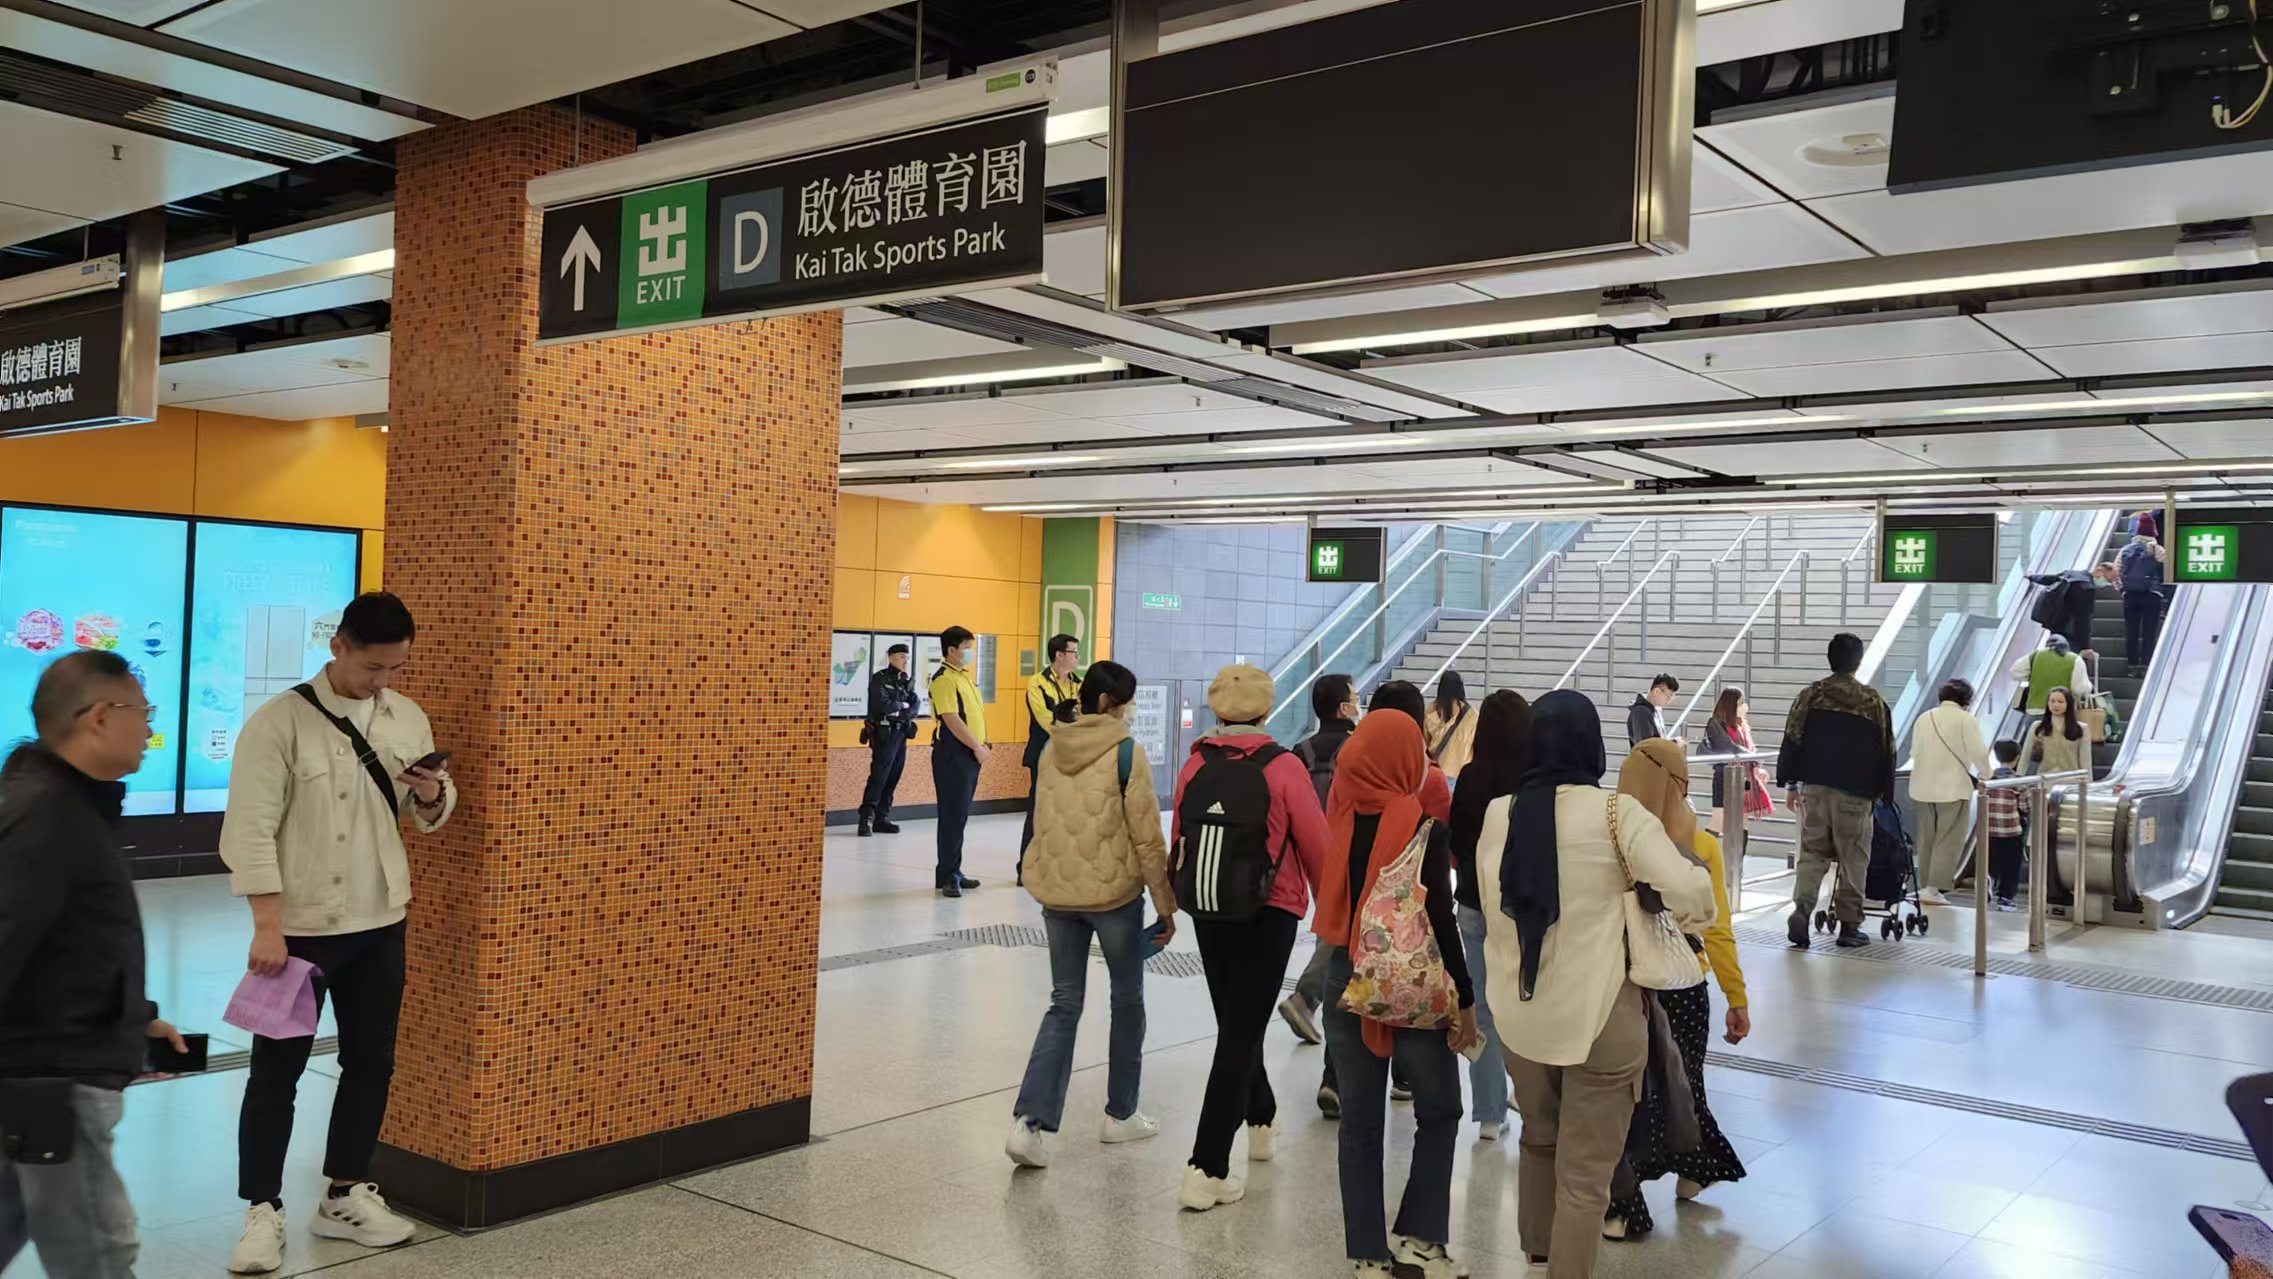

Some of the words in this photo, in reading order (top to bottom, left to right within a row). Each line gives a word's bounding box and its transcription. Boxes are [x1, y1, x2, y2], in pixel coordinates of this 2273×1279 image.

[797, 140, 1027, 238] 啟德體育園
[638, 205, 687, 277] 出
[733, 210, 769, 275] D
[795, 250, 826, 280] Kai
[831, 243, 868, 274] Tak
[873, 235, 947, 274] Sports
[953, 221, 1006, 257] Park
[636, 275, 686, 305] EXIT
[0, 335, 82, 386] 啟德體育園
[12, 390, 27, 410] Tak
[26, 388, 54, 412] Sports
[54, 382, 75, 404] Park
[1895, 537, 1926, 563] 出
[2188, 533, 2226, 562] 出
[1318, 566, 1337, 575] EXIT
[1895, 563, 1925, 574] EXIT
[2187, 562, 2225, 573] EXIT
[1051, 600, 1085, 643] D
